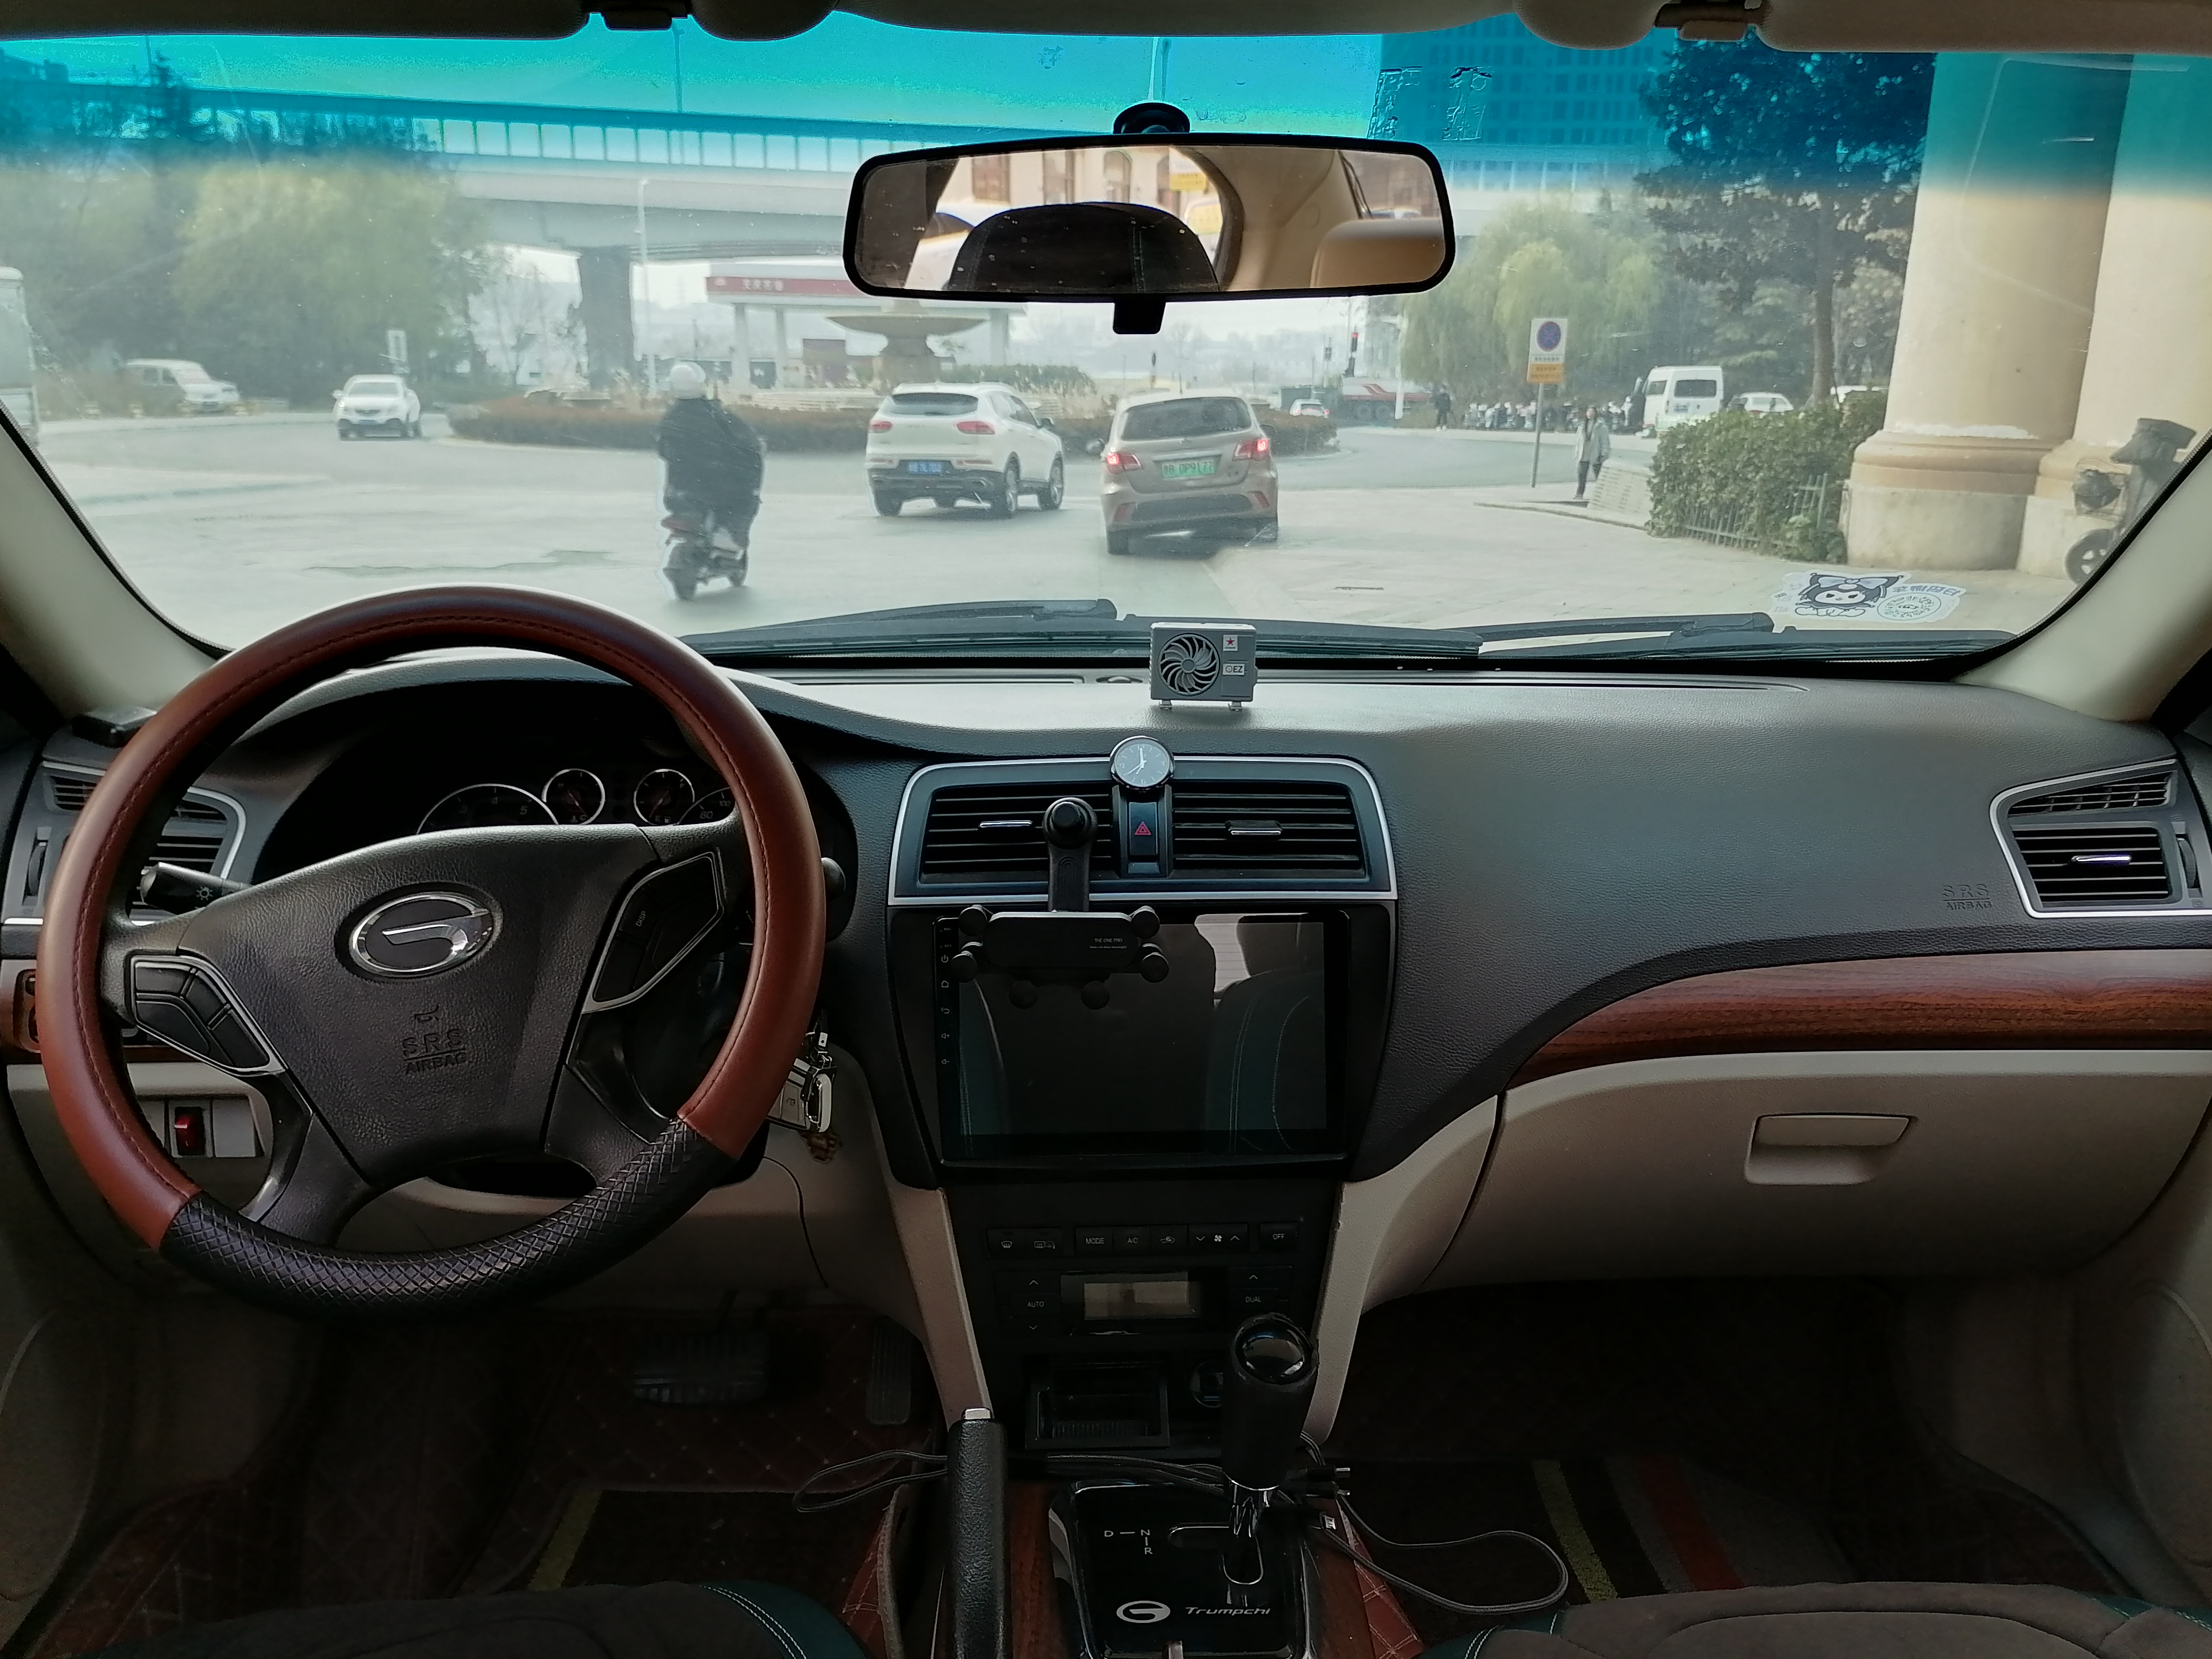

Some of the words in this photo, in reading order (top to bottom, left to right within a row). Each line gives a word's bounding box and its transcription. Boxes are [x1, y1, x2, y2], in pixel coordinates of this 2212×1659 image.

[1942, 883, 1990, 899] SRS
[1945, 901, 1992, 911] AIRBAG
[635, 910, 646, 927] DISP
[402, 1029, 465, 1056] SRS
[405, 1052, 468, 1074] AIRBAG
[1144, 1547, 1154, 1555] R
[1185, 1606, 1272, 1616] Trumpchi
